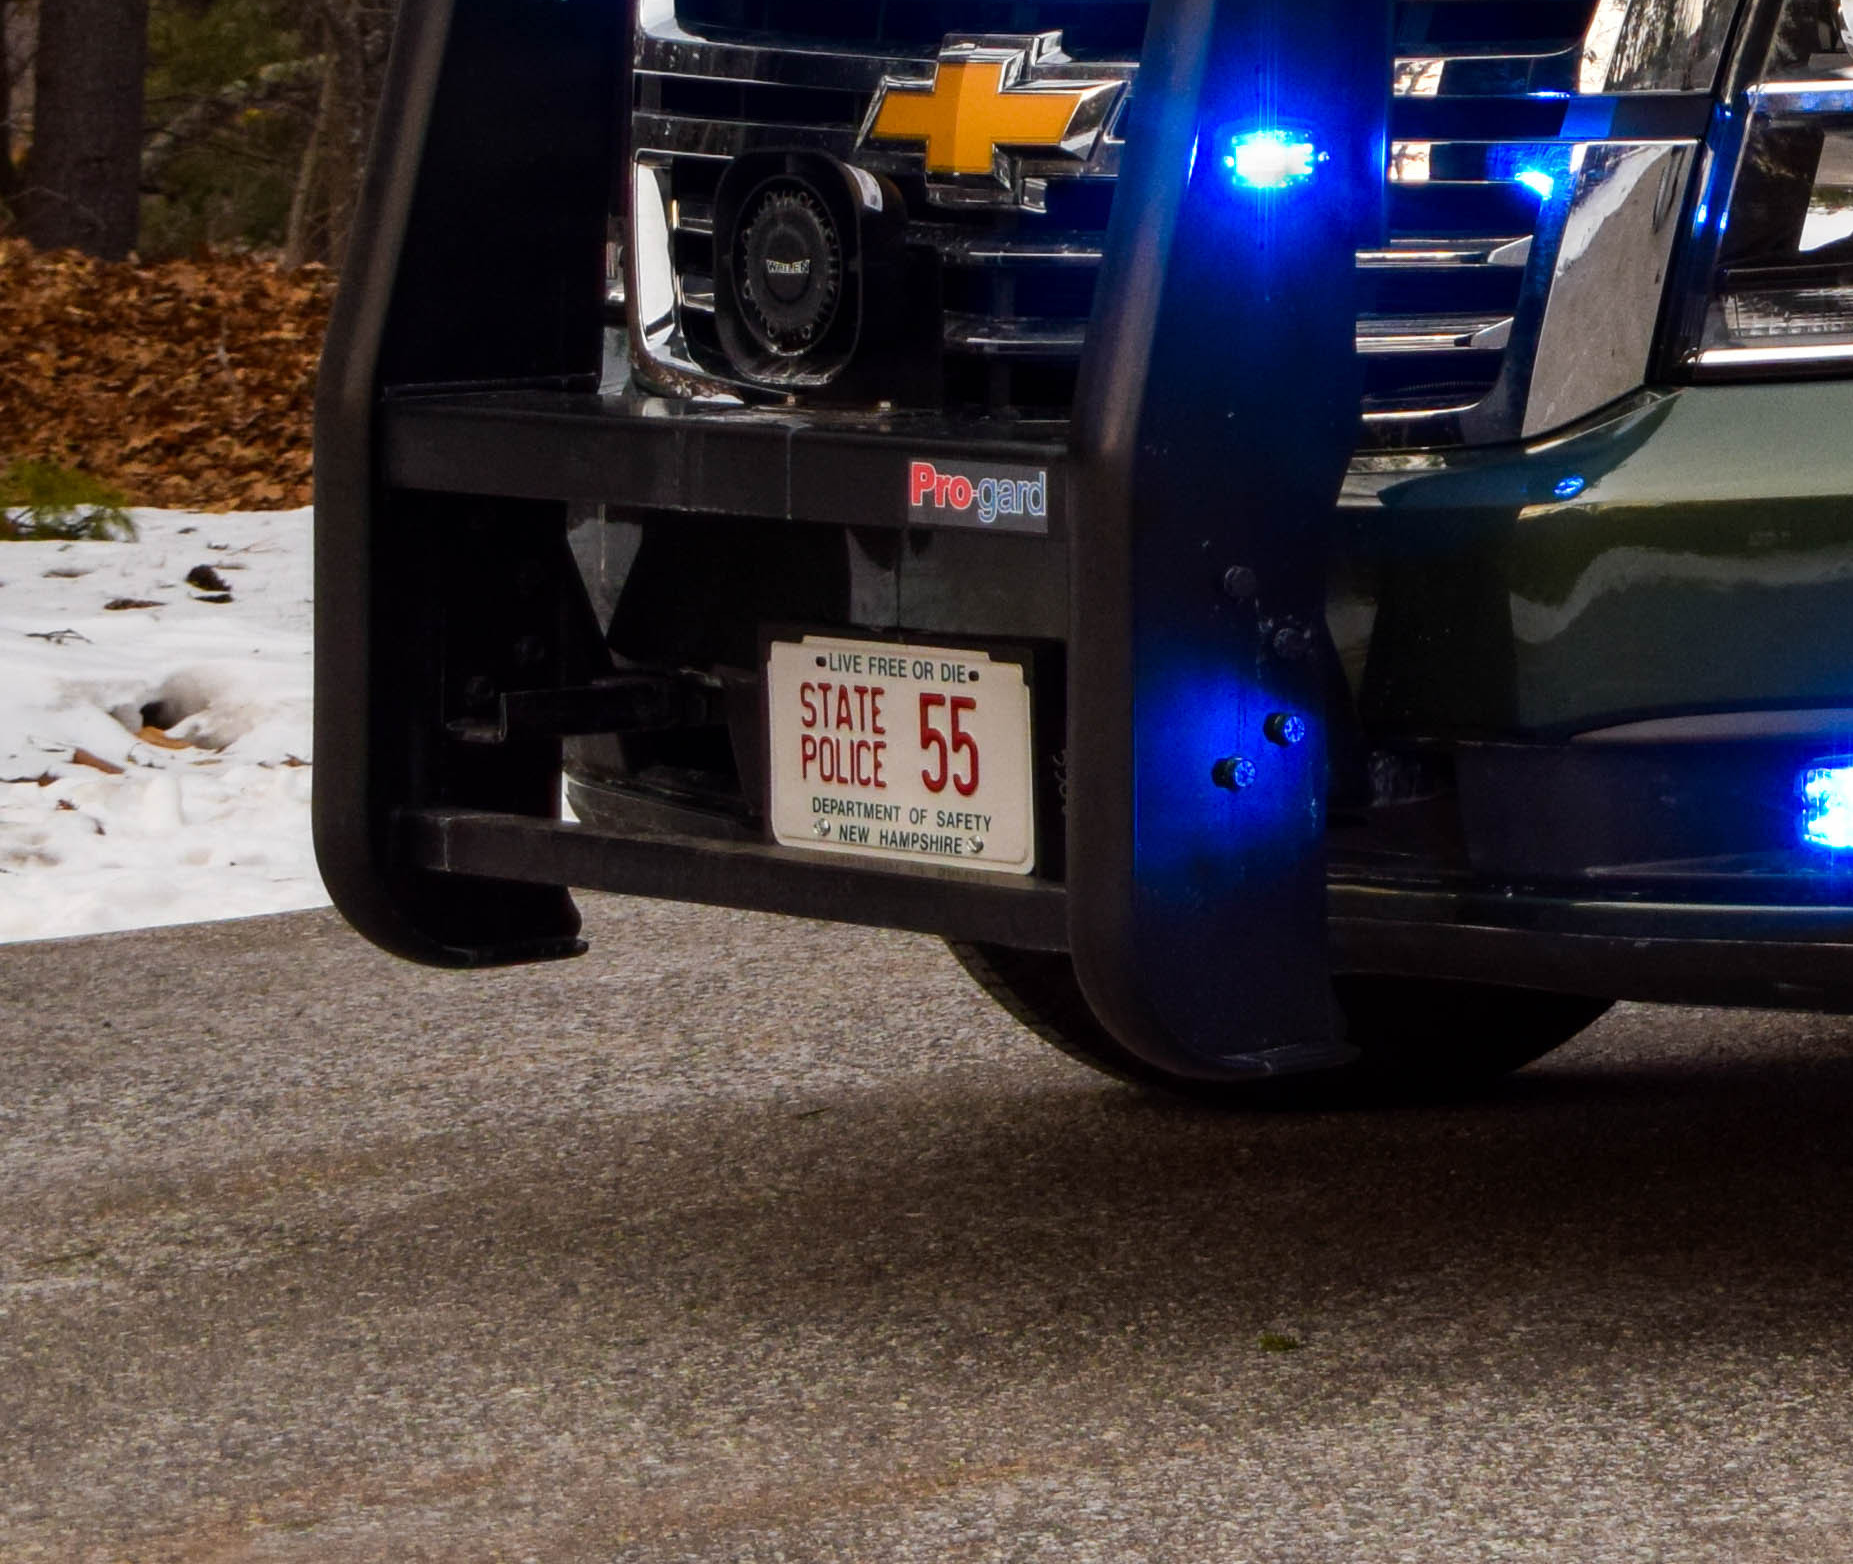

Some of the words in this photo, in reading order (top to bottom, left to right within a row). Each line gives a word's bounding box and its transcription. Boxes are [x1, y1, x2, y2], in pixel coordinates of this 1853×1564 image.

[911, 461, 1047, 523] Pro-gard
[829, 652, 862, 674] LIVE
[868, 656, 908, 678] FREE
[912, 660, 935, 680] OR
[940, 663, 967, 684] DIE
[800, 681, 886, 734] STATE
[801, 734, 887, 788] POLICE
[919, 692, 980, 796] 55
[812, 796, 902, 822] DEPARTMENT
[909, 807, 928, 825] OF
[936, 809, 992, 833] SAFETY
[838, 824, 870, 843] NEW
[879, 829, 963, 855] HAMPSHIRE
